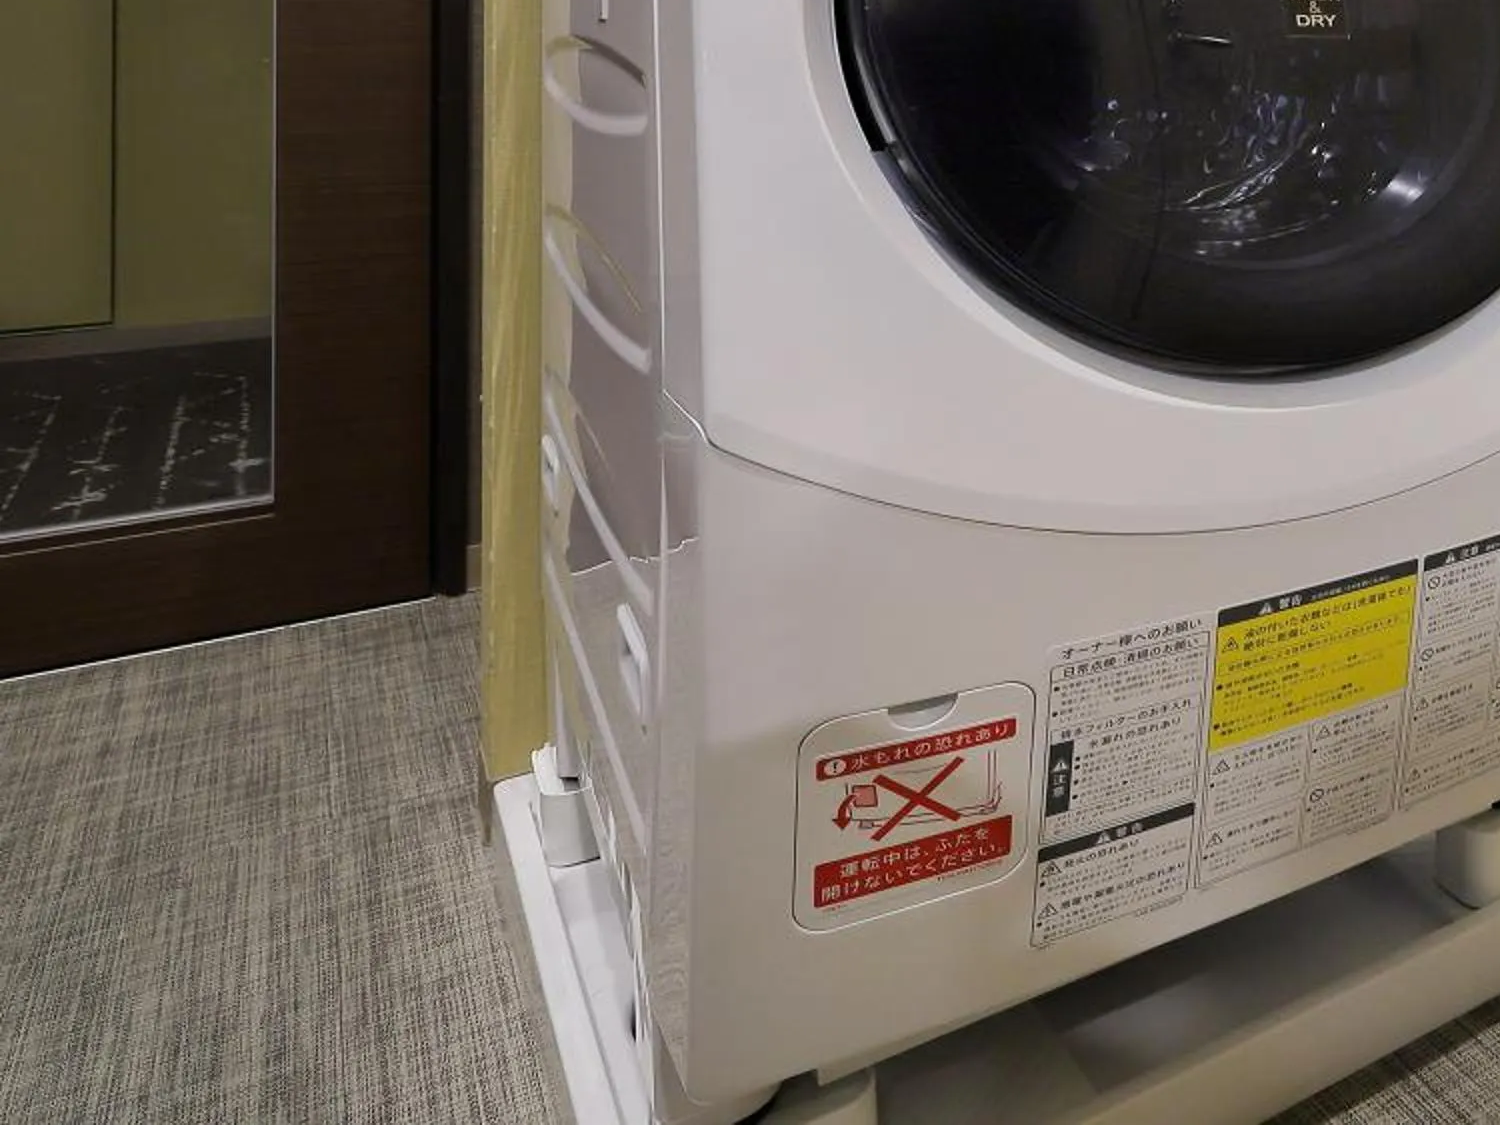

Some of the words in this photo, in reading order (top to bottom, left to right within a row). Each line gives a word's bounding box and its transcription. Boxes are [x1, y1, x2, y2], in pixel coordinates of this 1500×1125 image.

[1296, 14, 1336, 28] DRY
[1309, 1, 1321, 14] &
[851, 725, 1009, 770] 水もれの恐れあり
[840, 826, 989, 878] 運転中は、ふたを
